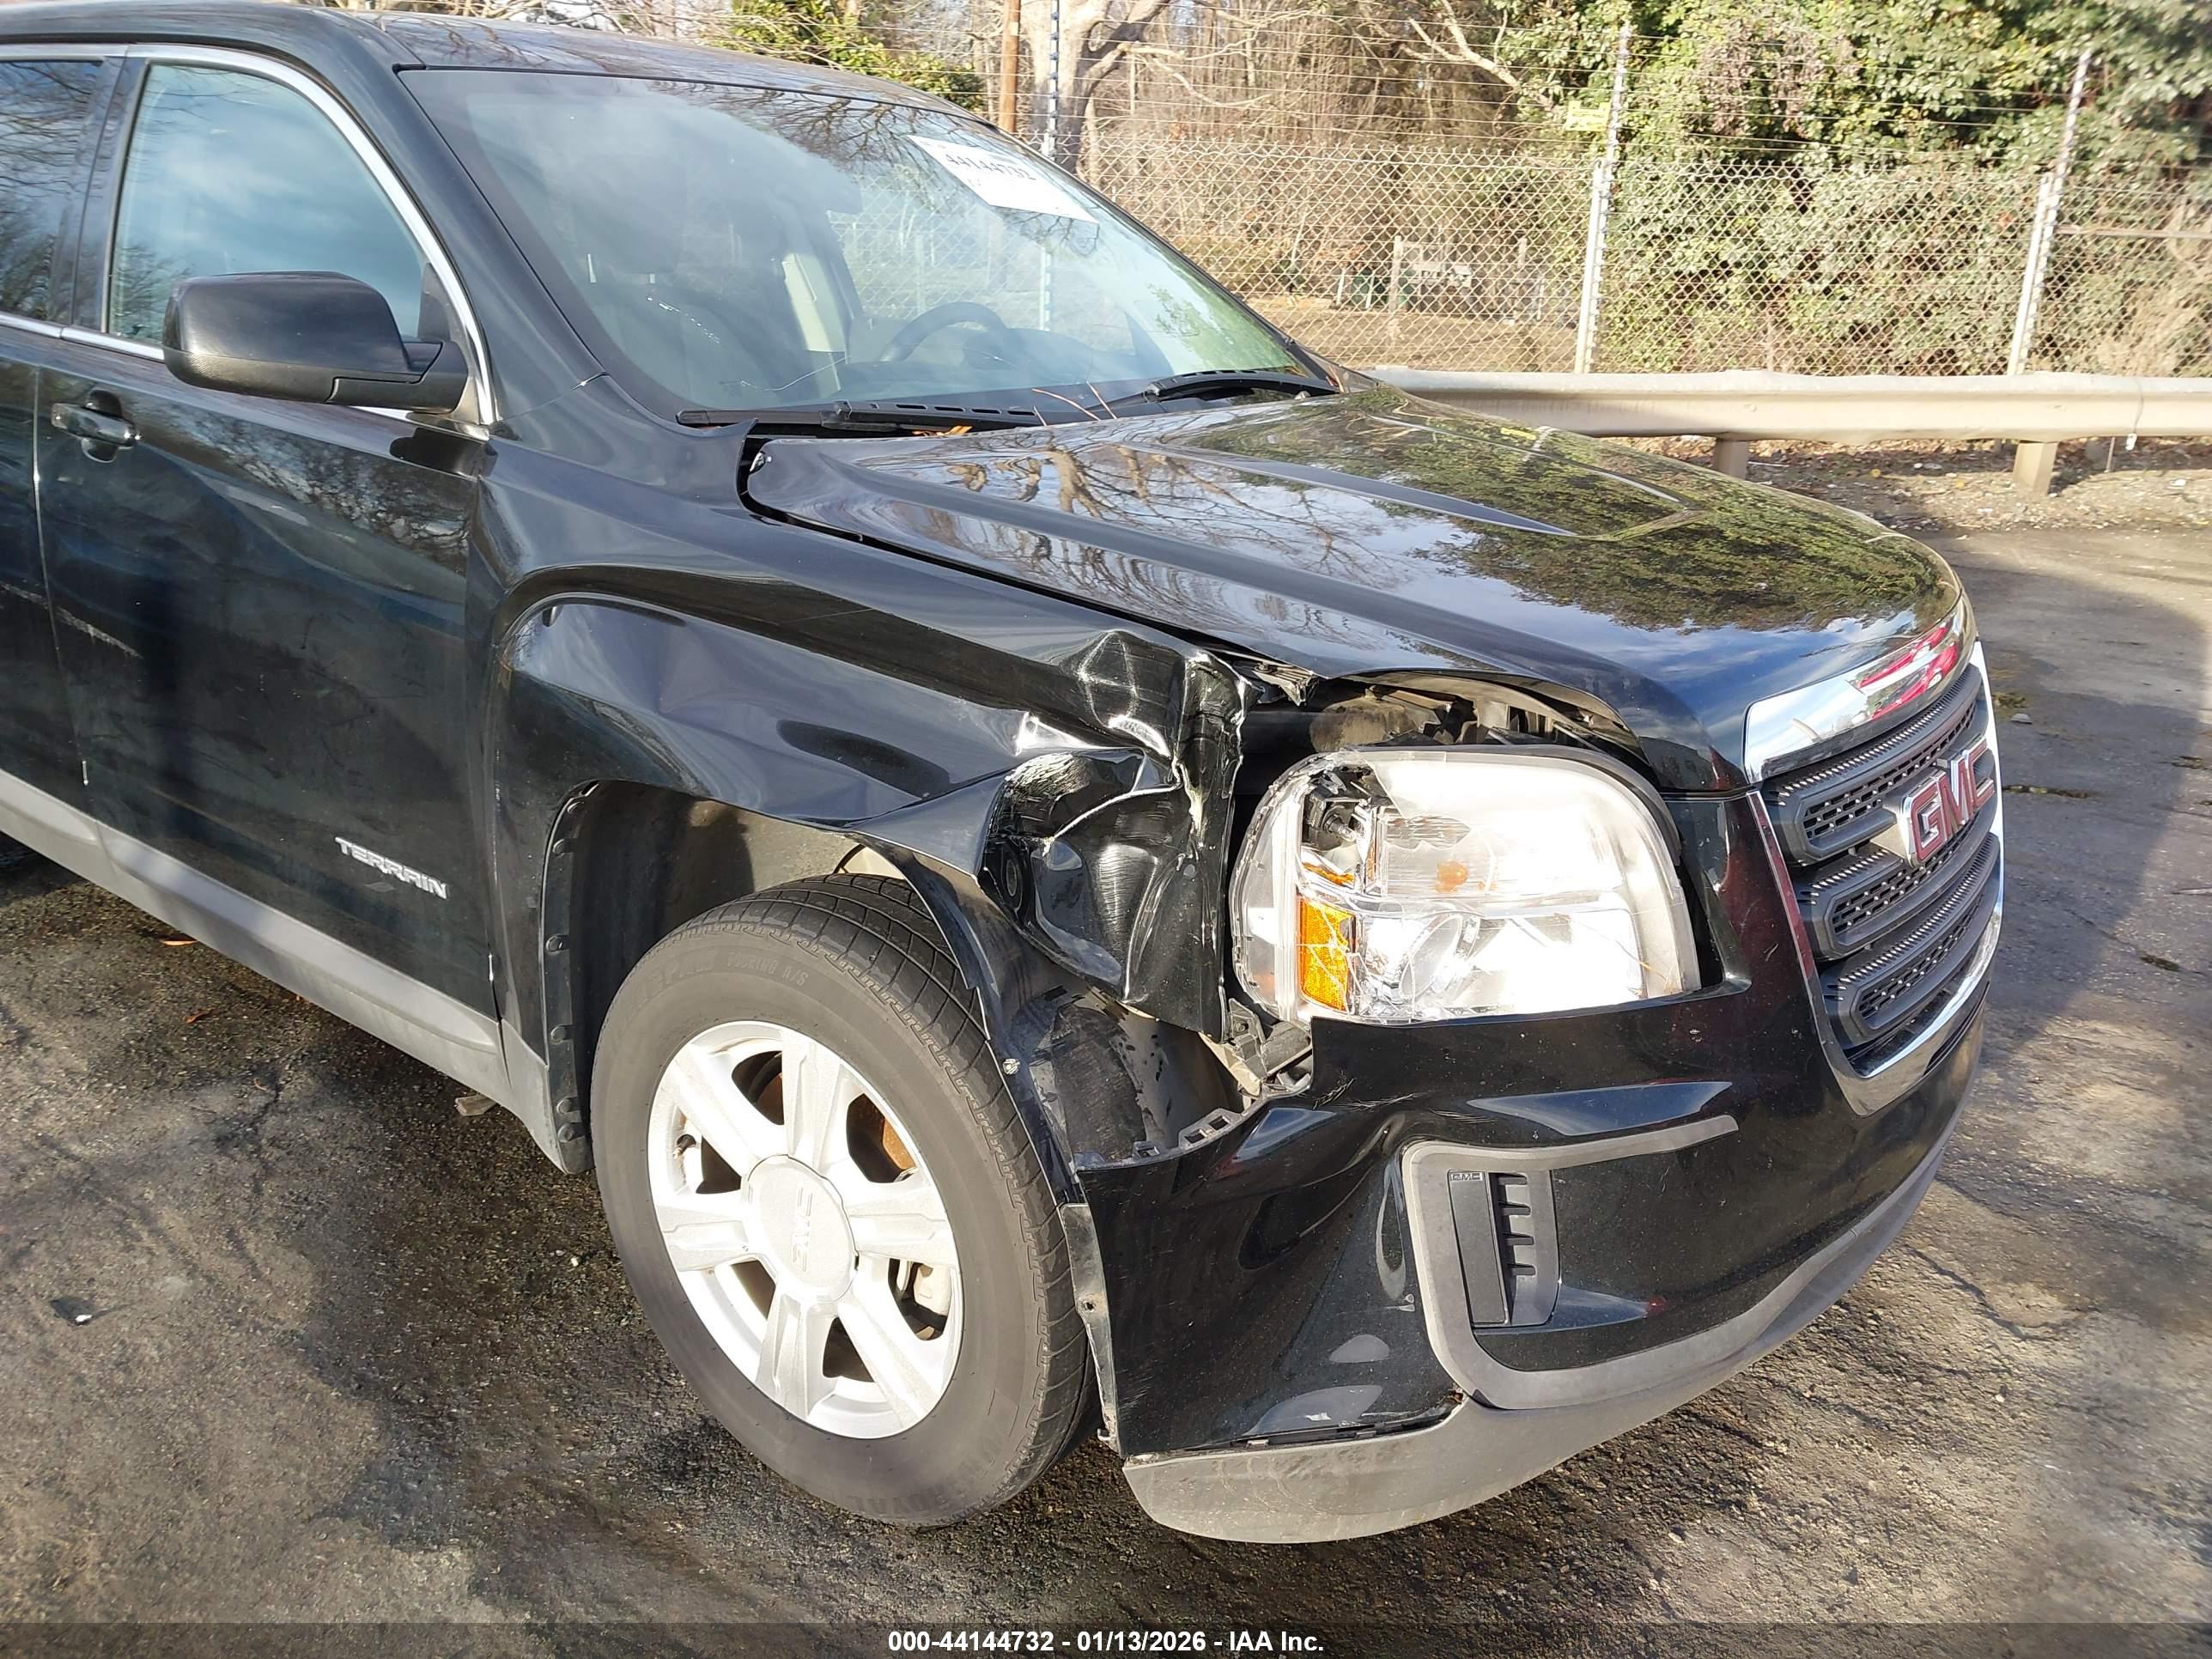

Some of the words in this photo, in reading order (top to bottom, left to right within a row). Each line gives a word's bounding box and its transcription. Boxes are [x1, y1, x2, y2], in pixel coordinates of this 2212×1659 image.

[1904, 735, 1995, 863] GMC
[334, 836, 448, 900] TERRAIN
[1452, 1172, 1480, 1181] GMC
